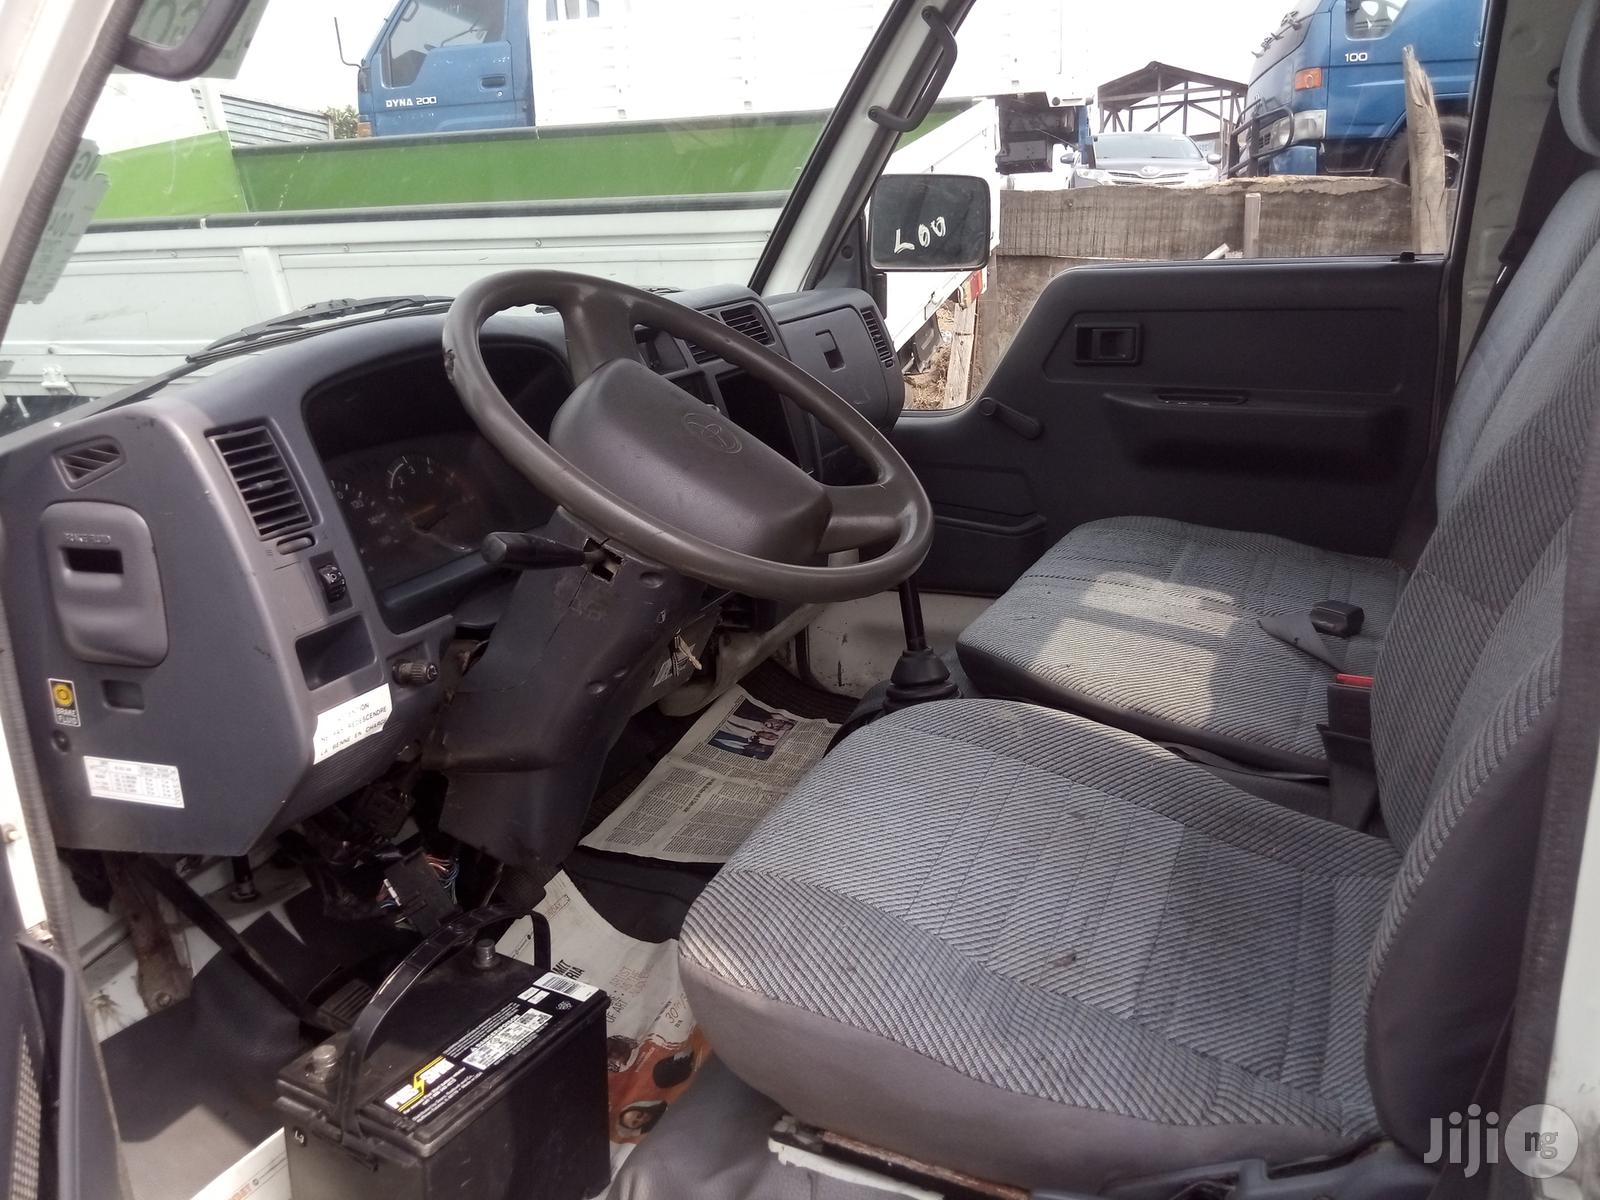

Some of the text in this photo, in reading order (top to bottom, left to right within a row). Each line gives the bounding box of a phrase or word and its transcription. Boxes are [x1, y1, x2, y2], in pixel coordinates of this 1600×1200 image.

[1344, 52, 1368, 62] 100
[385, 96, 437, 108] DYNA 200
[56, 707, 78, 718] BRAKE
